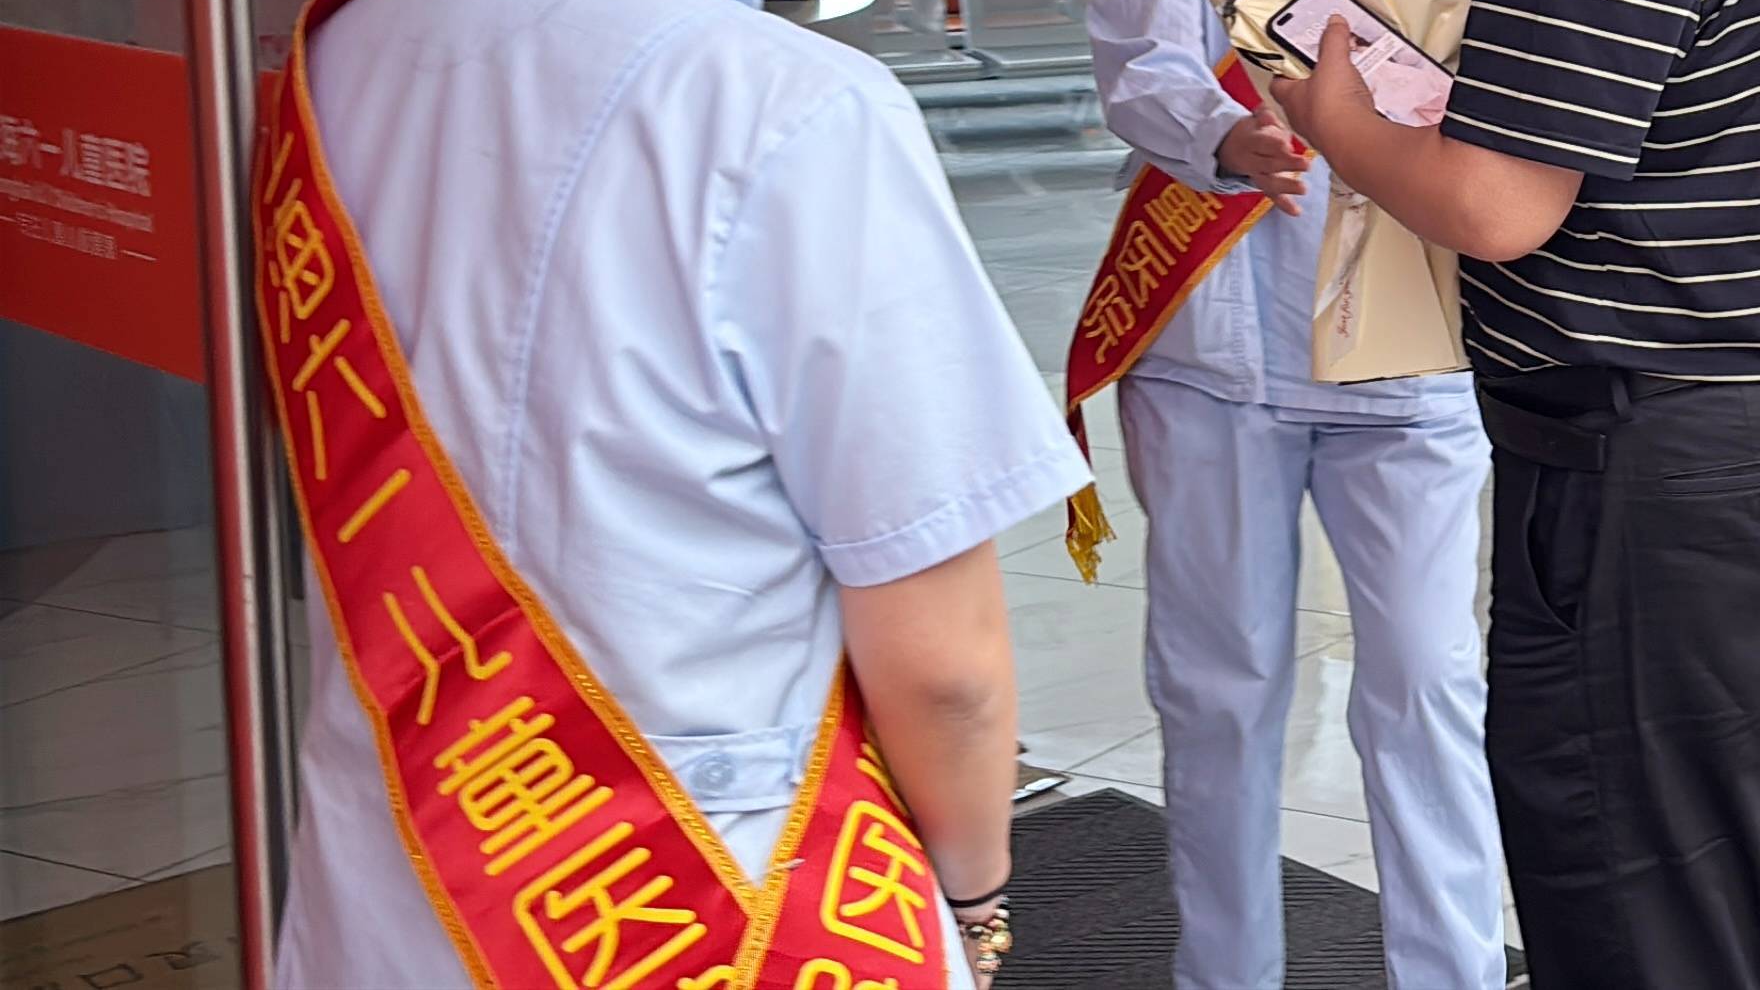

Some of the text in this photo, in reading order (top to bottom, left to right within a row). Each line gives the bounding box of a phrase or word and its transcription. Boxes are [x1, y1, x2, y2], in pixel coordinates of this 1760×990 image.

[262, 130, 736, 990] 海六一儿童医
